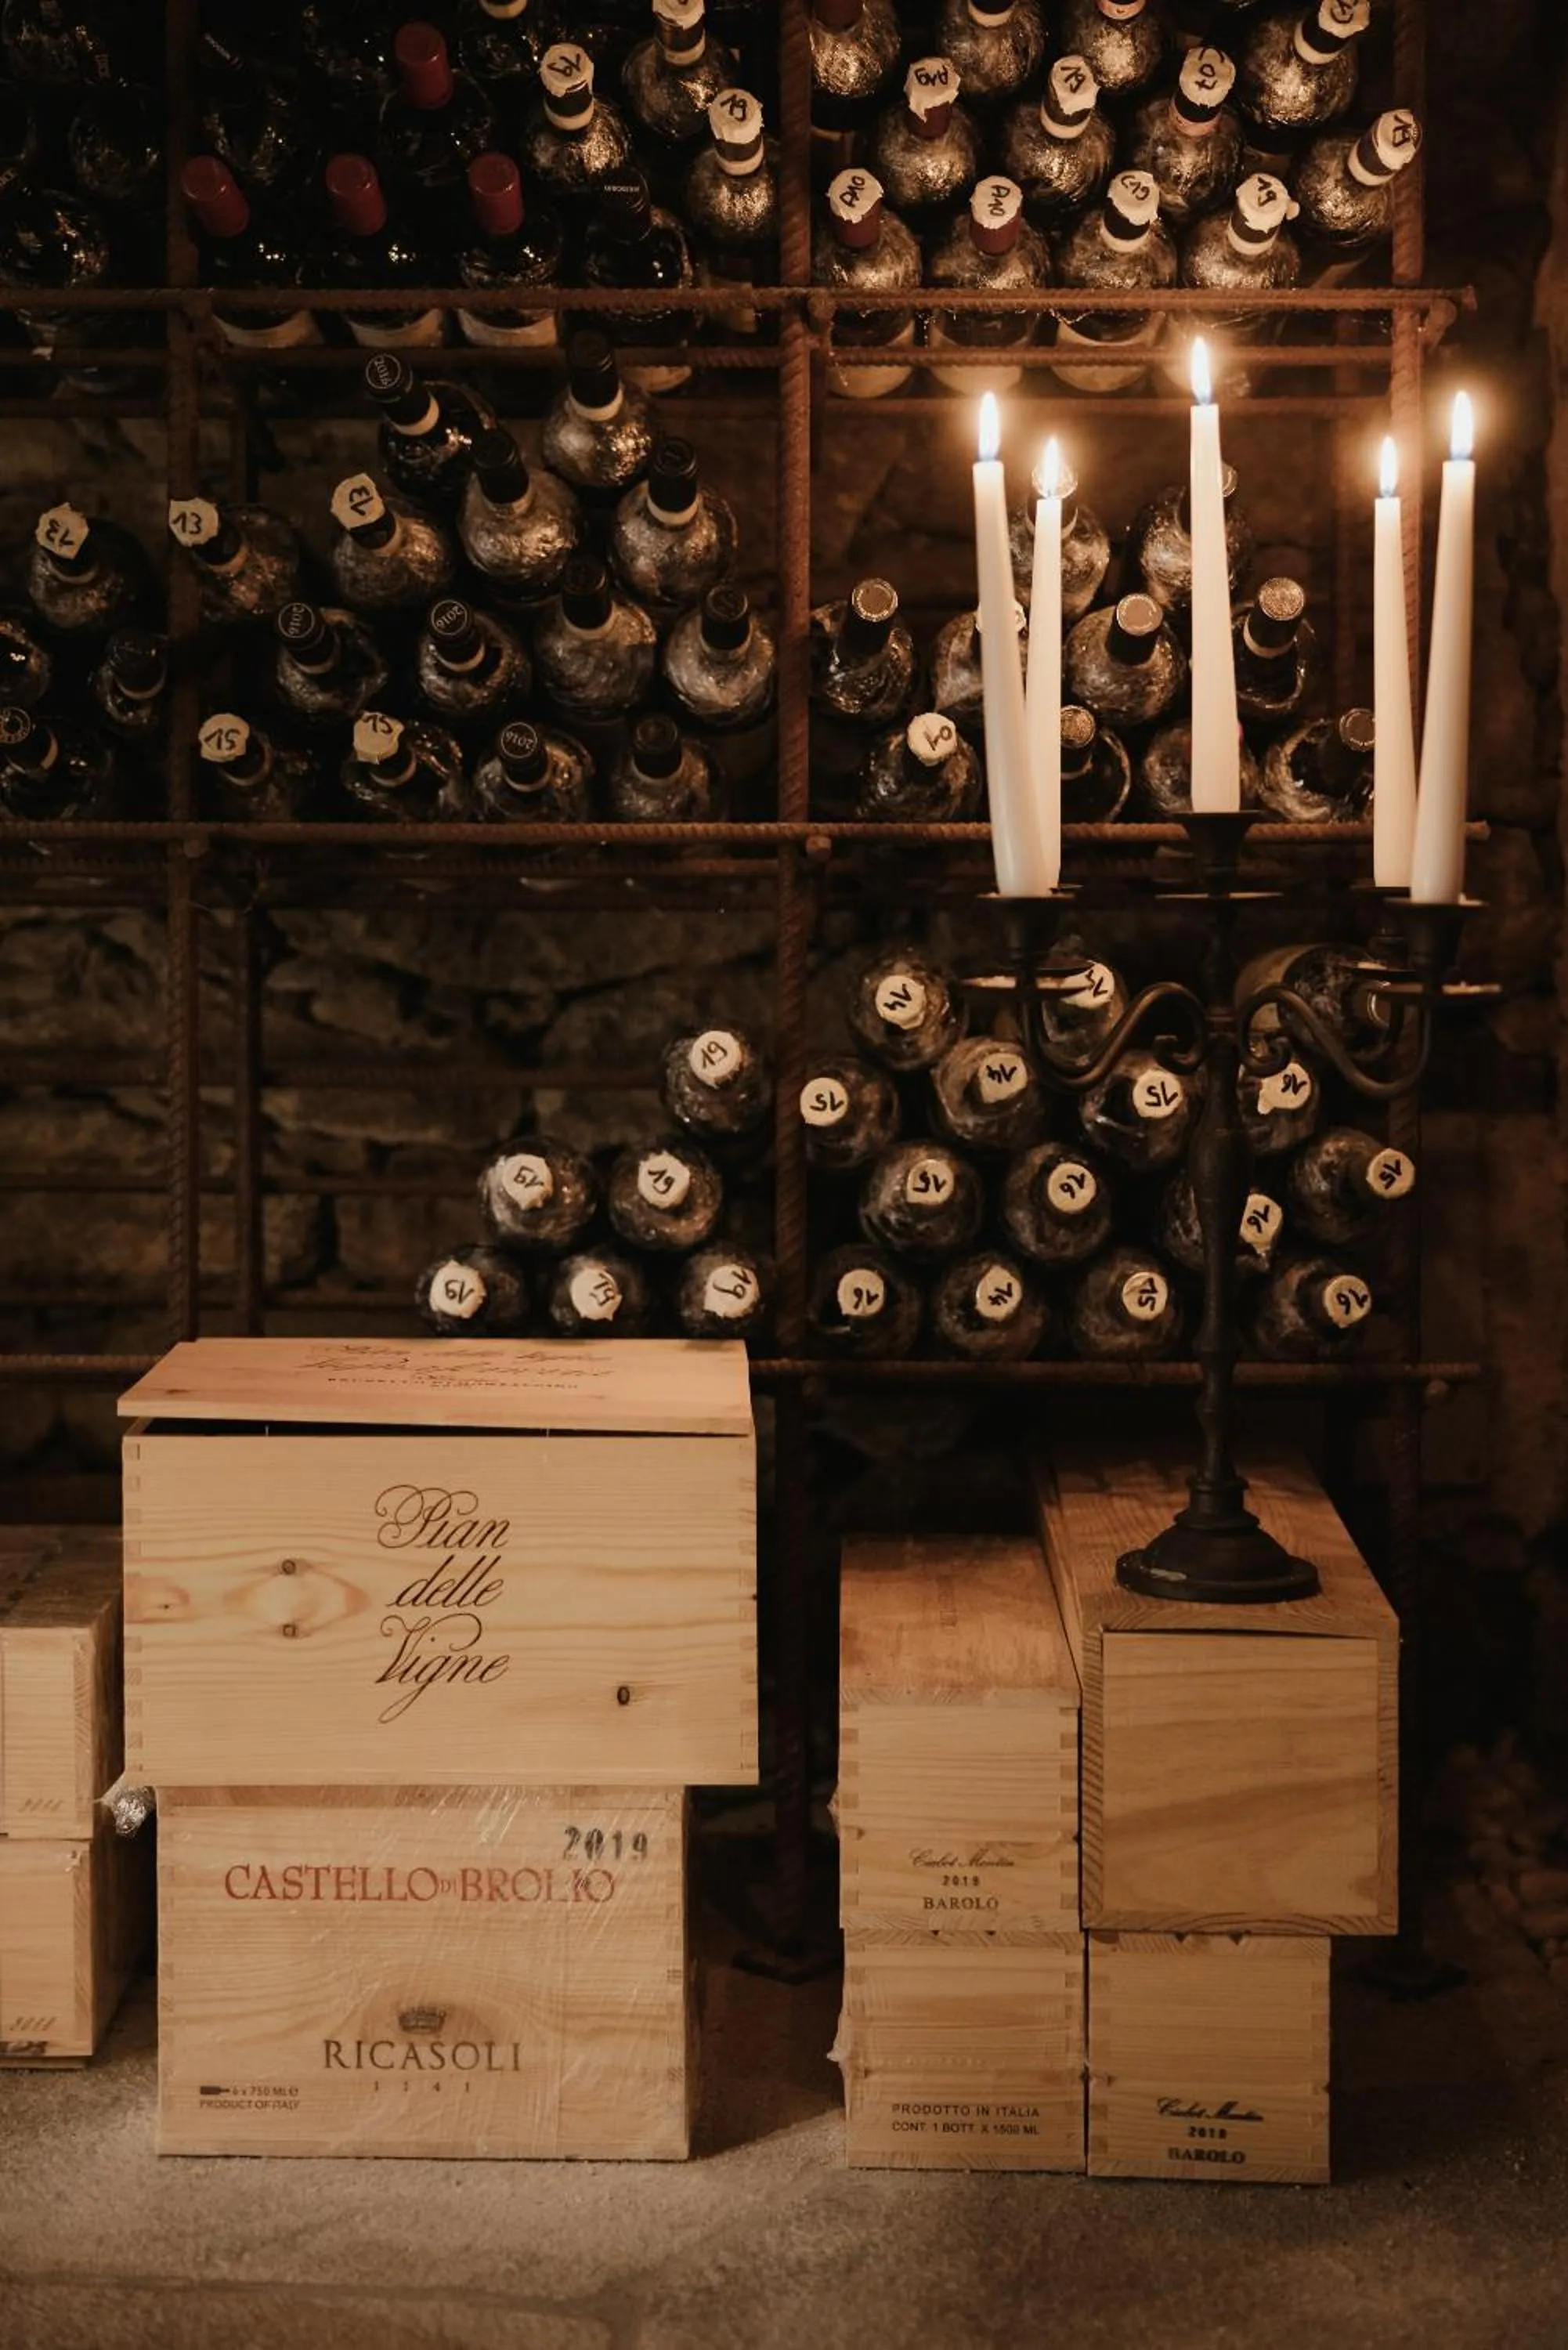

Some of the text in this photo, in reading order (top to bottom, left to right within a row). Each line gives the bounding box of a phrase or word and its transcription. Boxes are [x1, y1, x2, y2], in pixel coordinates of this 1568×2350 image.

[172, 512, 201, 535] 13
[362, 714, 393, 734] 15
[204, 728, 240, 750] 15
[810, 1091, 844, 1111] 15
[1145, 1081, 1178, 1106] 15
[374, 1484, 510, 1549] Pian
[385, 1555, 504, 1607] delle
[376, 1613, 510, 1724] Vigne
[562, 1825, 648, 1862] 2019
[225, 1864, 439, 1902] CASTELLO
[459, 1867, 616, 1903] BROLIO
[923, 1896, 999, 1910] BAROLO
[323, 2039, 522, 2071] RICASOLI
[200, 2099, 252, 2110] PRODUCT
[255, 2100, 269, 2110] OF
[891, 2103, 1040, 2117] PRODOTTO IN ITALIA
[1022, 2124, 1040, 2135] ML
[1168, 2147, 1246, 2164] BAROLO
